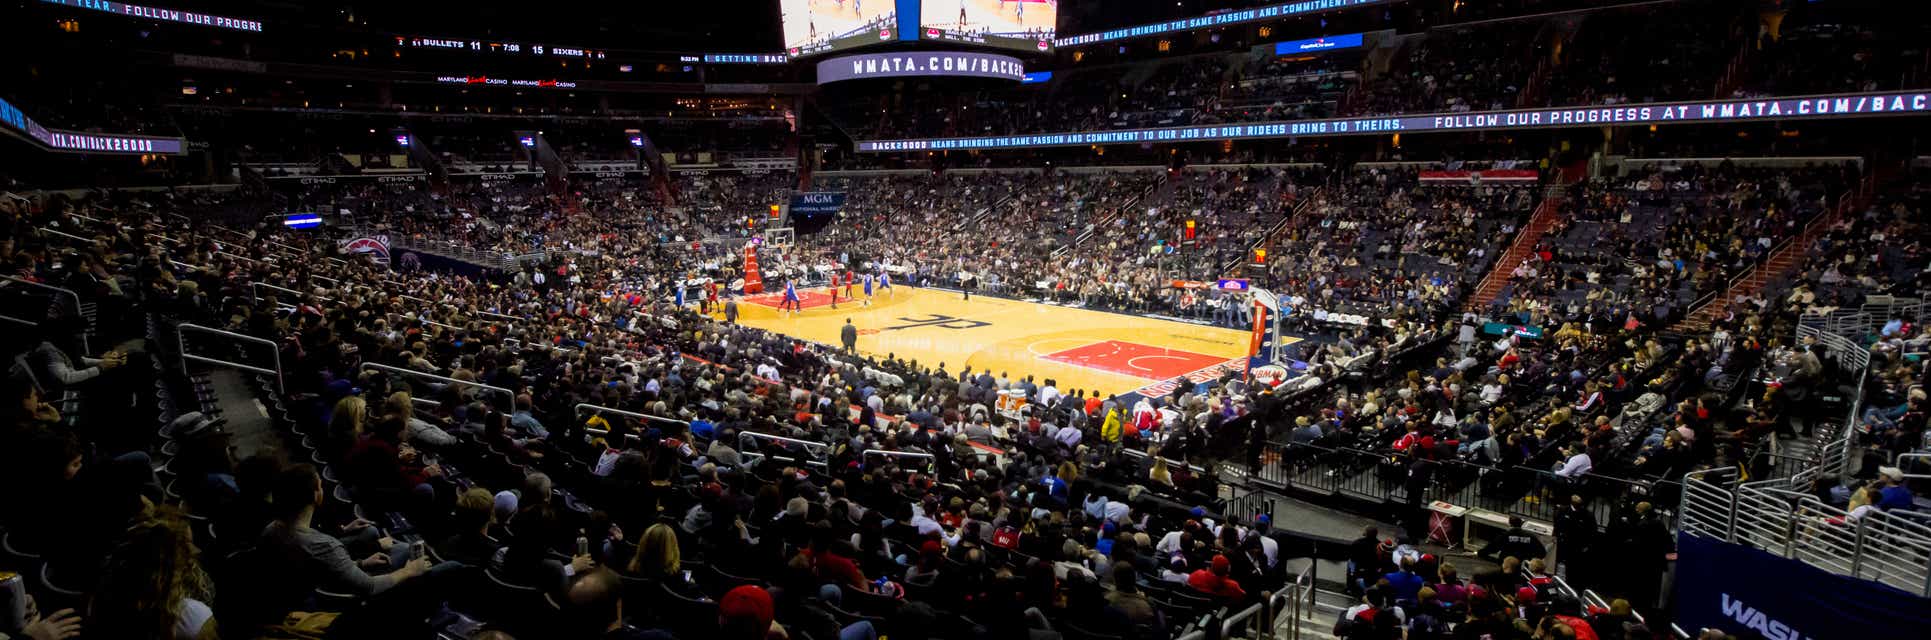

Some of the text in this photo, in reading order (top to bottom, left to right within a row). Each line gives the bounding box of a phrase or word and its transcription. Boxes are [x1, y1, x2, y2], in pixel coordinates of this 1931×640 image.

[125, 5, 180, 21] FOLLOW
[186, 12, 211, 25] OUR
[1104, 29, 1128, 40] MEANS
[1132, 23, 1168, 36] BRINGING
[1171, 20, 1186, 31] THE
[1190, 17, 1213, 28] SAME
[1216, 11, 1255, 24] PASSION
[1259, 7, 1278, 18] AND
[424, 39, 464, 48] BULLETS
[470, 41, 480, 50] 11
[532, 46, 544, 54] 15
[553, 48, 583, 56] SIXERS
[1435, 114, 1498, 128] FOLLOW
[1507, 112, 1541, 125] OUR
[1550, 107, 1652, 124] PROGRESS
[1663, 105, 1688, 119] AT
[872, 119, 1405, 150] BACK2GOOD MEANS BRINGING THE SAME PASSION AND COMMITMENT TO OUR JOB AS OUR RIDERS BRING TO THEIRS.
[804, 194, 832, 204] MGM
